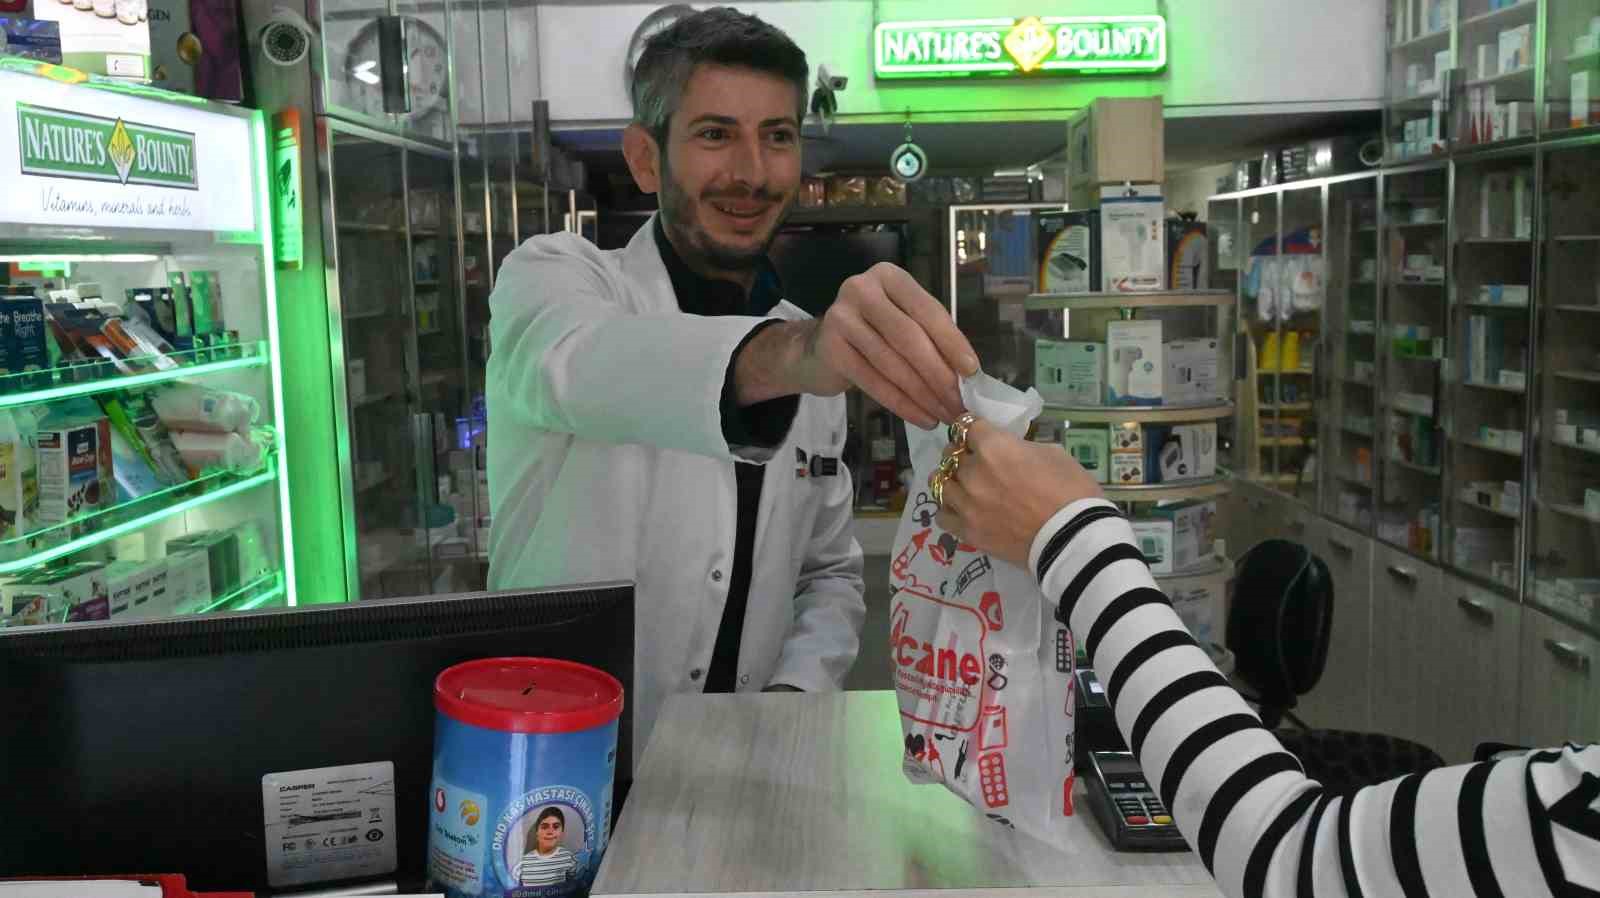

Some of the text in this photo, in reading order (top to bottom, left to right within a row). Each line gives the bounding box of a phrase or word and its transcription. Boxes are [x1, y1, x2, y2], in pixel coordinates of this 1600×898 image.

[884, 27, 1158, 61] NATURE'S BOUNTY
[24, 116, 106, 167] NATURE'S
[41, 188, 99, 216] Vitamins,
[101, 196, 144, 216] minerals
[146, 198, 165, 216] and
